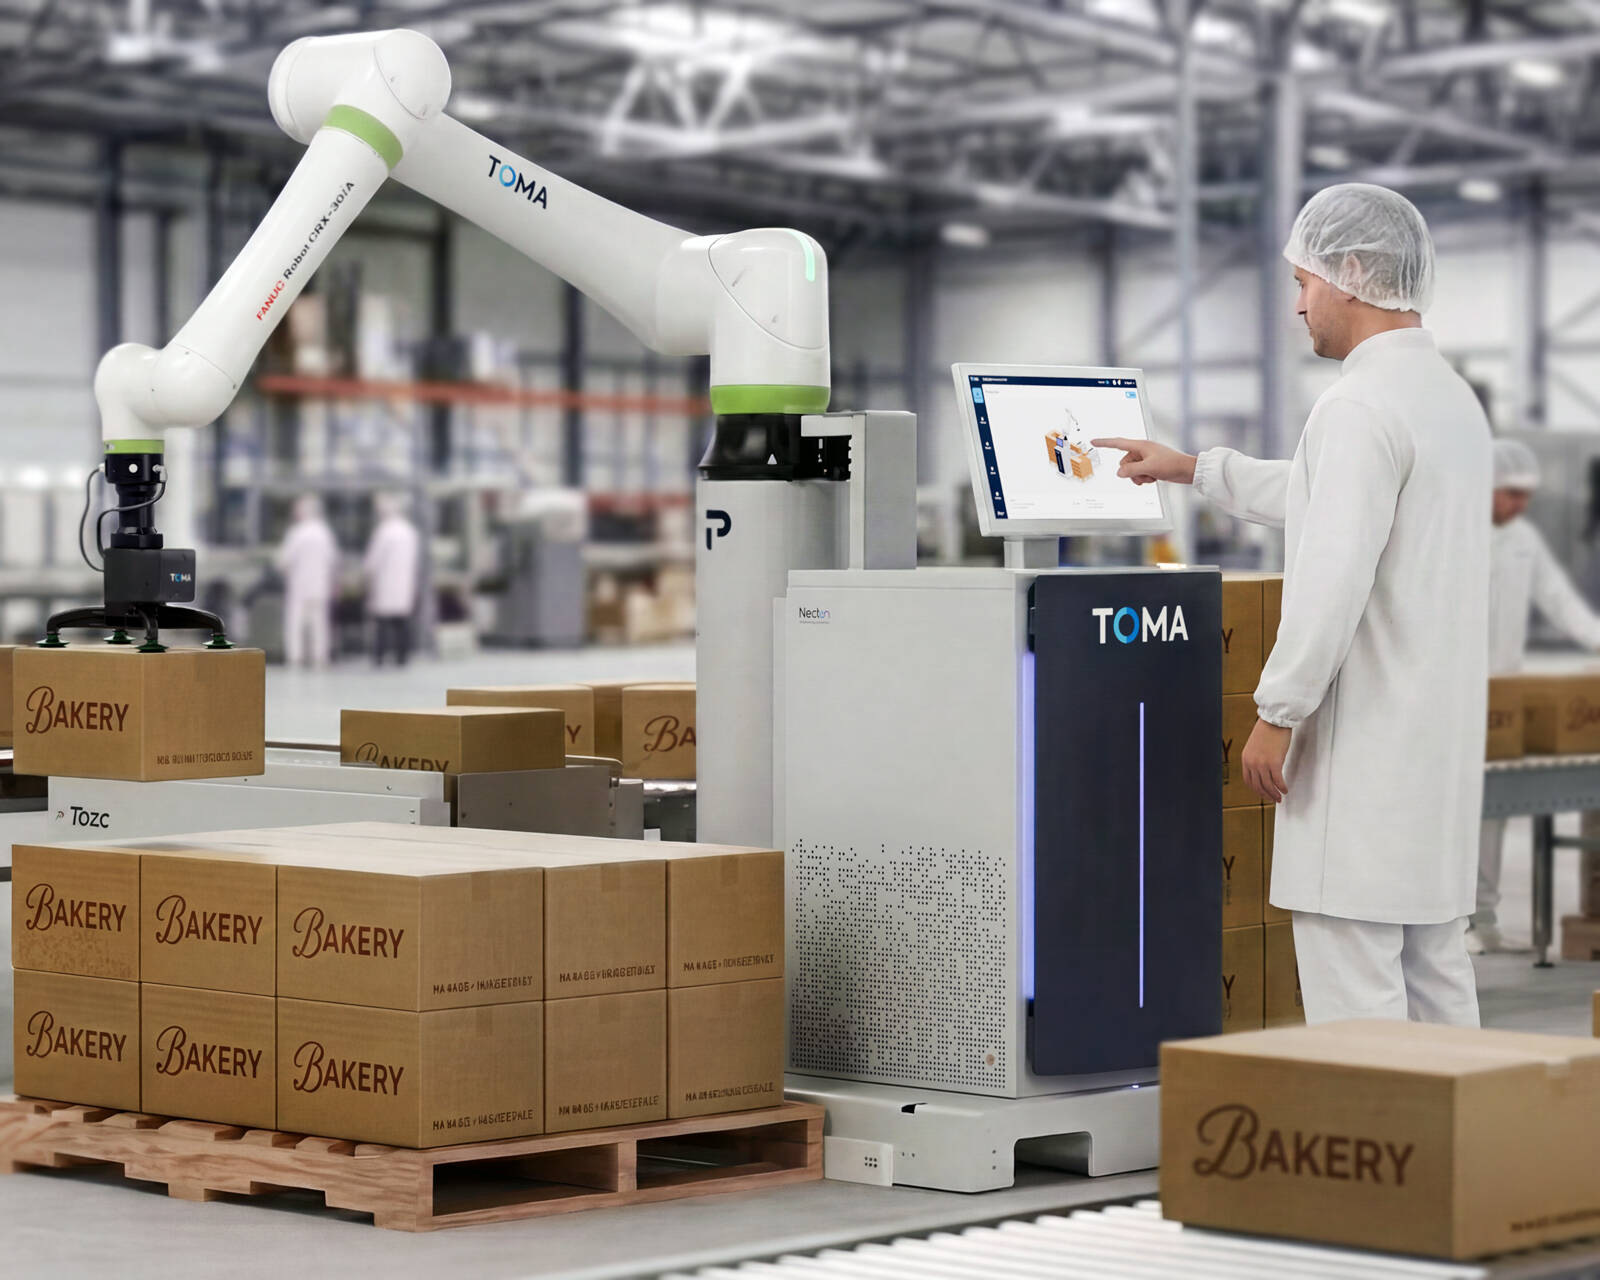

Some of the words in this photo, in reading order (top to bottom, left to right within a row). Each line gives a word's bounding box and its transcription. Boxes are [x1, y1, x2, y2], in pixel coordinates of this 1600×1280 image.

[489, 154, 547, 210] TOMA
[256, 280, 285, 320] FANUC
[283, 244, 310, 280] Robot
[1092, 605, 1189, 644] TOMA
[26, 686, 129, 734] BAKERY
[26, 883, 127, 932] BAKERY
[155, 894, 263, 945] BAKERY
[292, 907, 404, 959] BAKERY
[26, 1010, 127, 1062] BAKERY
[155, 1025, 263, 1078] BAKERY
[293, 1041, 404, 1095] BAKERY
[1192, 1103, 1415, 1187] BAKERY
